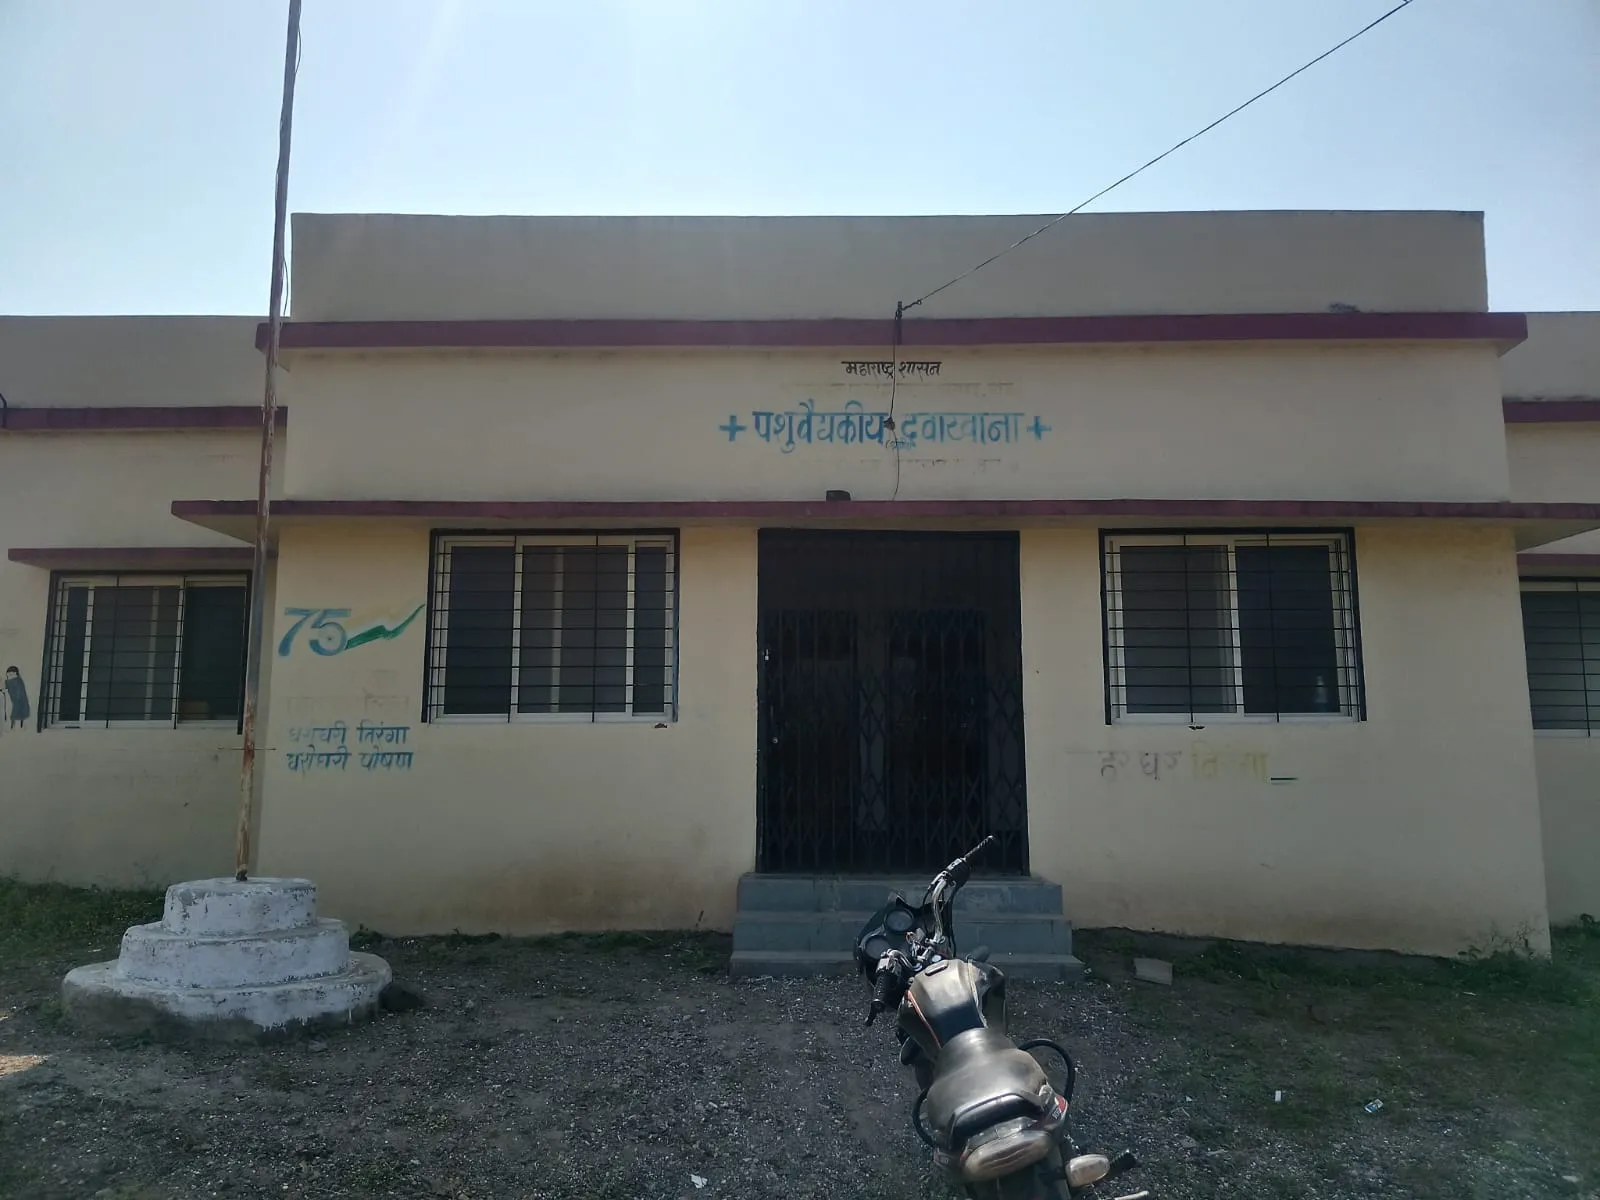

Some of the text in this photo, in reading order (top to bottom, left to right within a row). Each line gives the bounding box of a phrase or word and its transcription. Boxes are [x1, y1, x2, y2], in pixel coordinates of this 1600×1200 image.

[841, 361, 942, 380] महाराष्ट्र शासन
[278, 607, 351, 657] 75
[356, 719, 410, 744] तिरंगा
